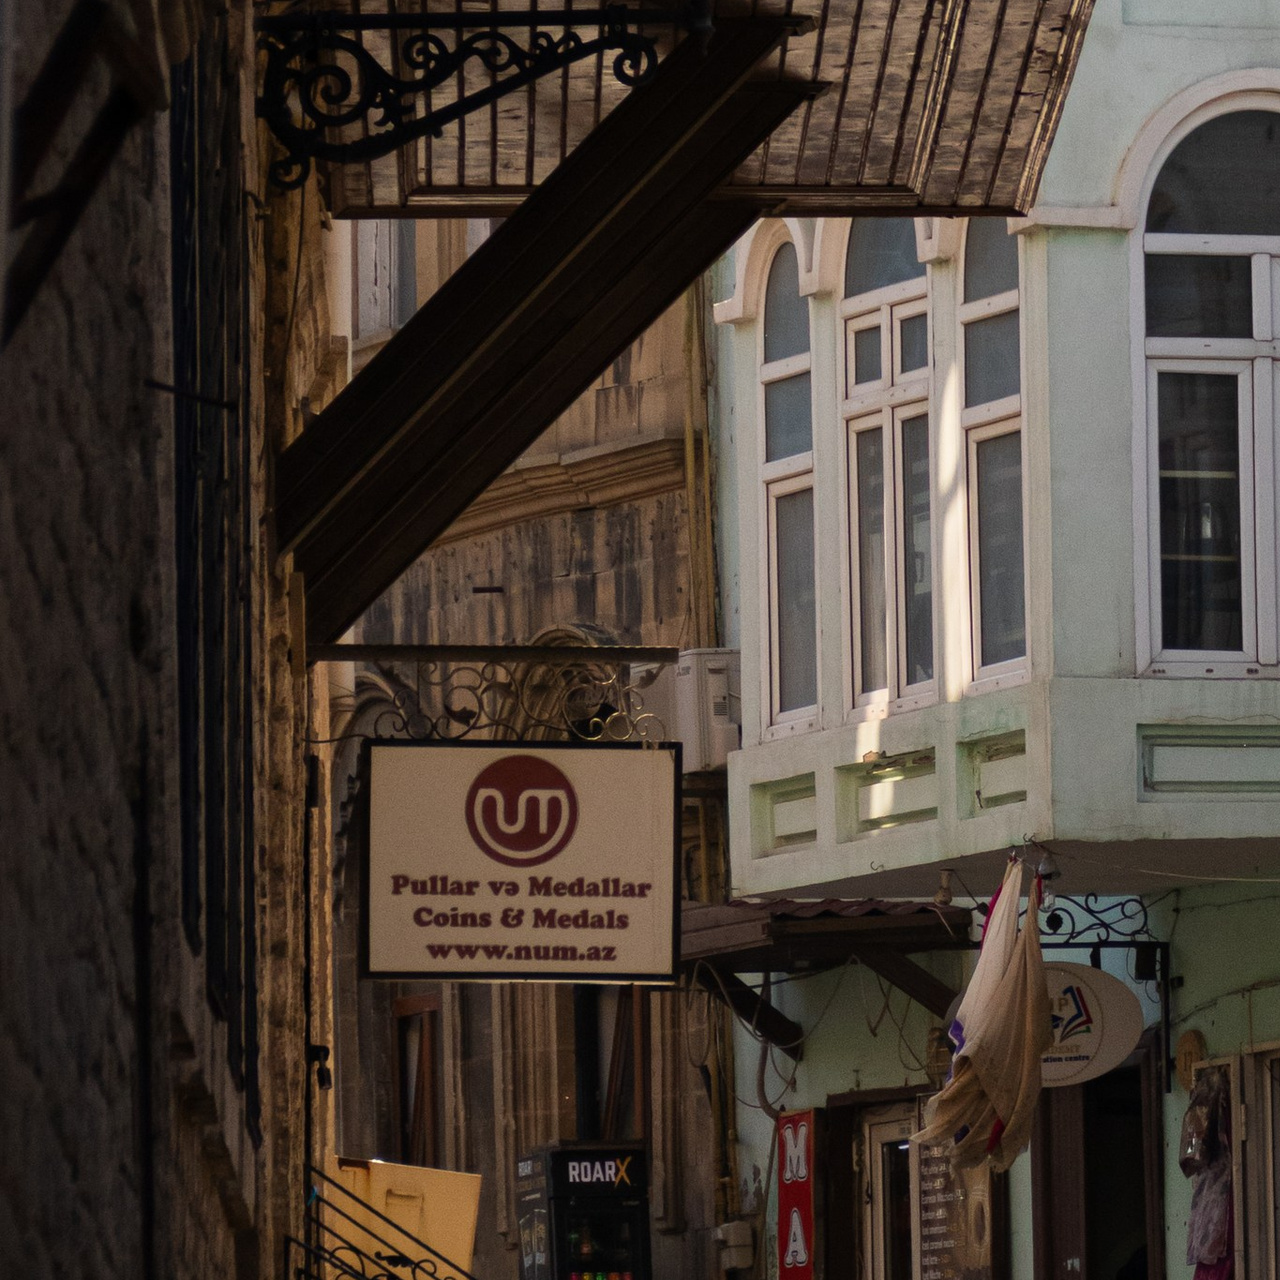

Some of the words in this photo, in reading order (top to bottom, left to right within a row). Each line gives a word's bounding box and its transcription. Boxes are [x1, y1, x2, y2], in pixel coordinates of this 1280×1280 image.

[391, 874, 480, 896] Pullar
[488, 880, 520, 897] və
[528, 876, 652, 898] Medallar
[413, 907, 492, 928] Coins
[500, 907, 525, 928] &
[532, 908, 630, 930] Medals
[426, 943, 617, 961] www.num.az
